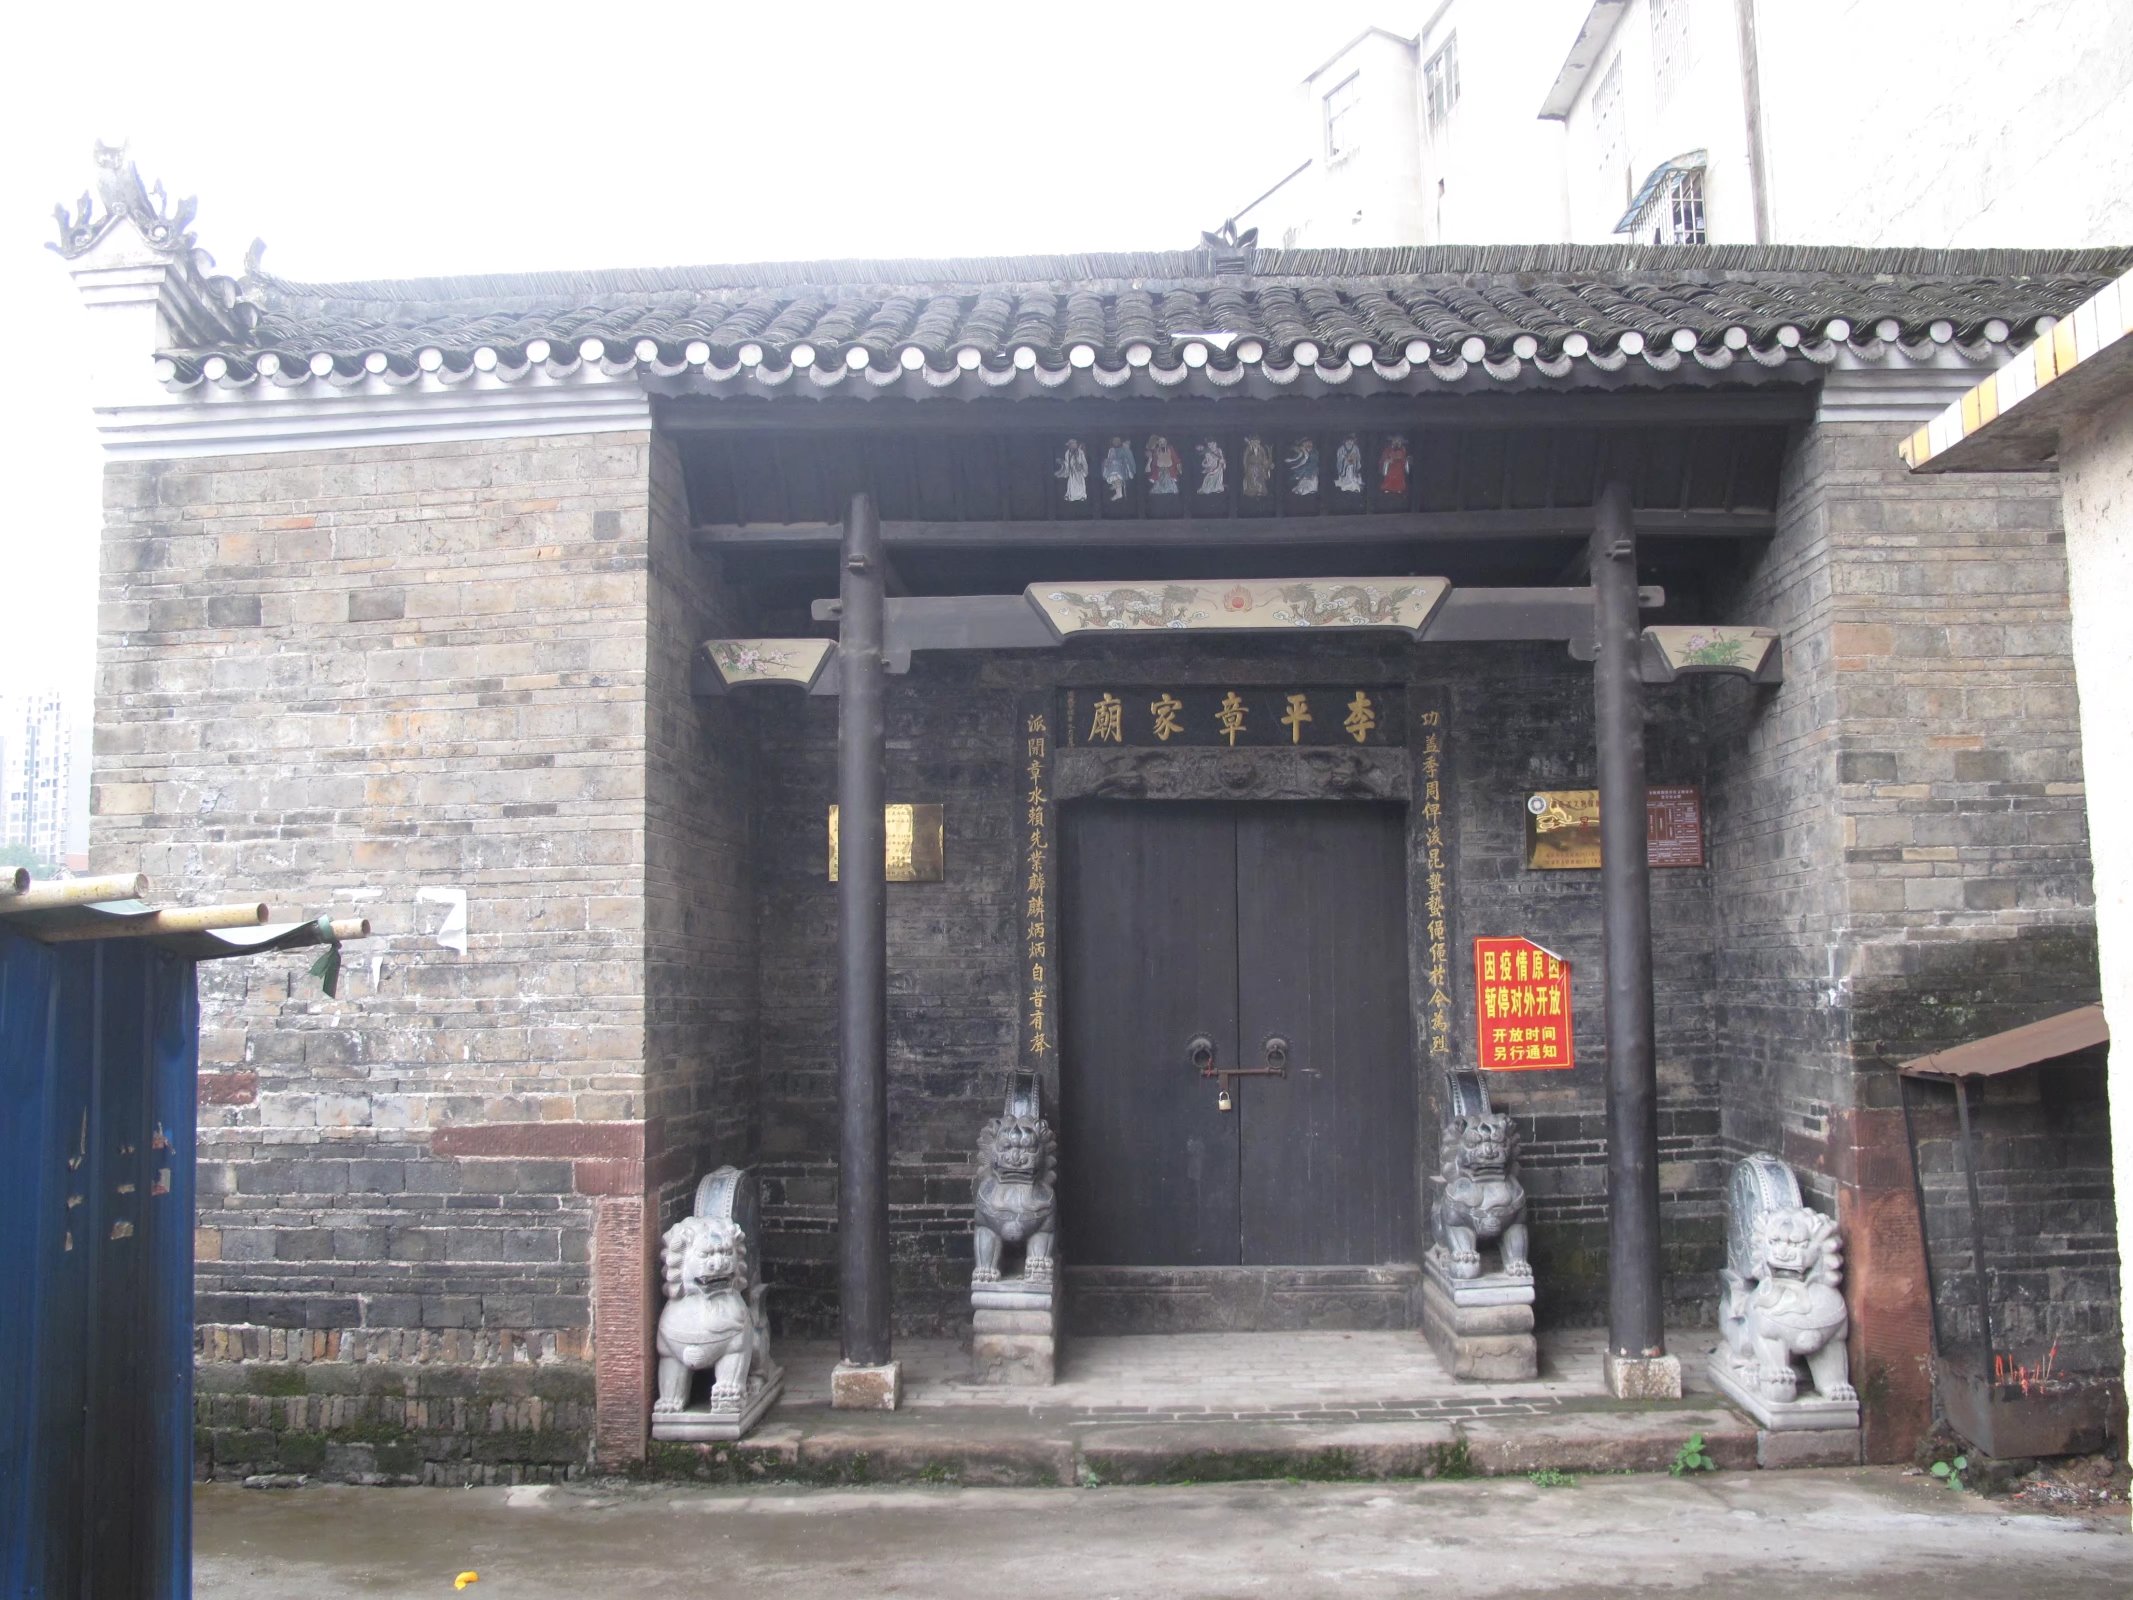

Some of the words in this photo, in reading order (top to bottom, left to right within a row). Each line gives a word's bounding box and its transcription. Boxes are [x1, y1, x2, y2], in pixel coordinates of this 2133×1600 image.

[1483, 949, 1560, 981] 因疫情原因
[1484, 984, 1561, 1018] 暂停对外开放
[1492, 1026, 1557, 1043] 开放时间
[1493, 1044, 1558, 1061] 另行通知
